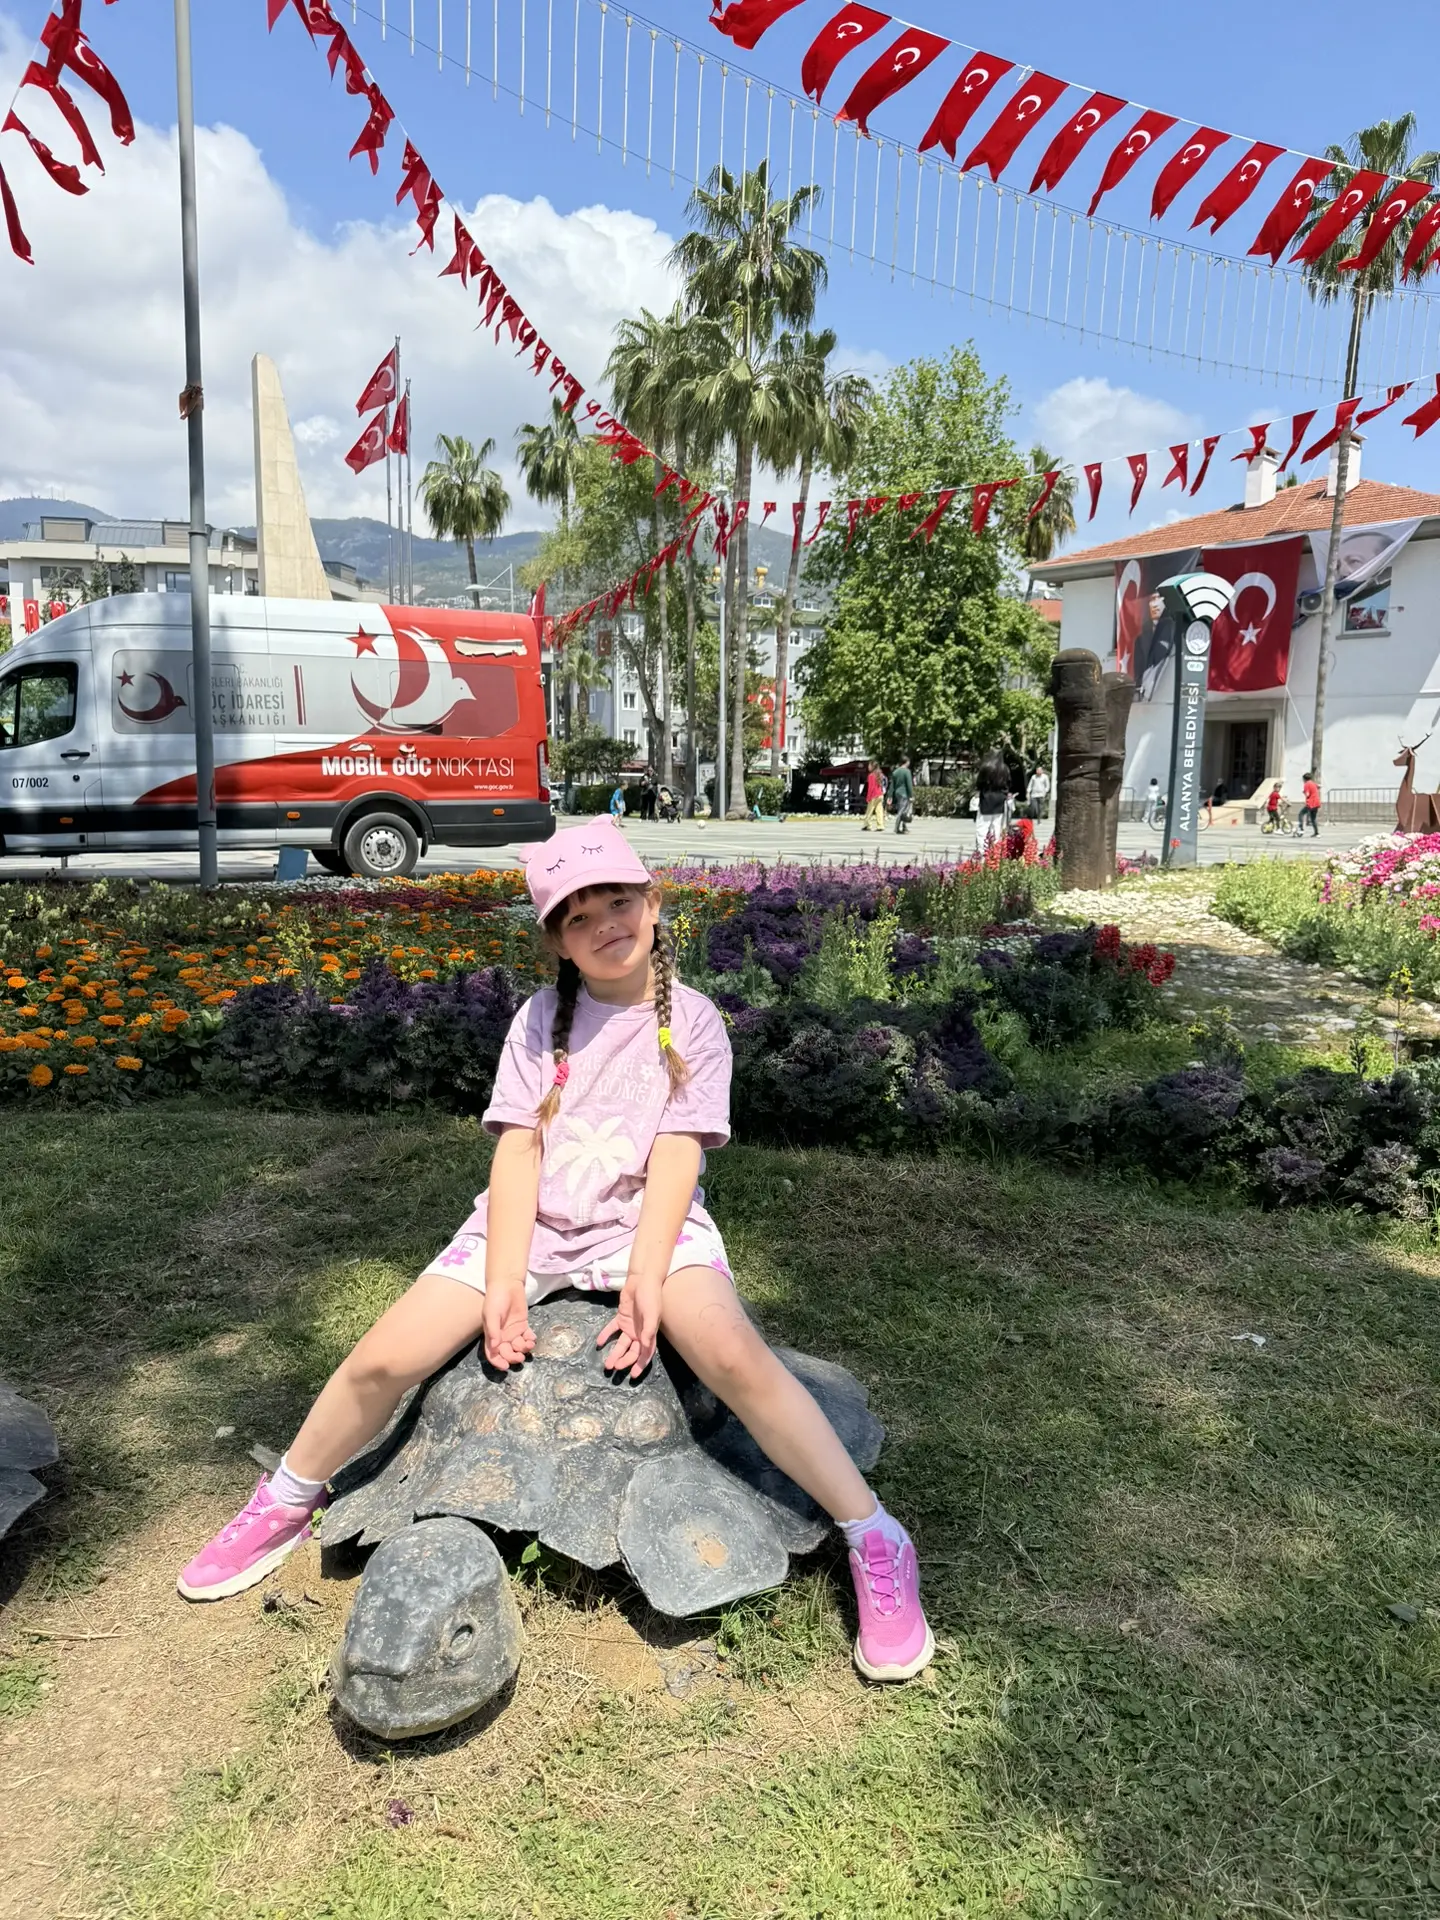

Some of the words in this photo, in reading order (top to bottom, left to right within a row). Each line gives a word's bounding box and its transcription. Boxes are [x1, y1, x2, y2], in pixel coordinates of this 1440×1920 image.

[231, 691, 284, 709] İDARESİ
[212, 712, 286, 728] AŞKANLIĞI
[1184, 682, 1200, 768] BELEDİYESİ
[322, 753, 388, 776] MOBİL
[393, 753, 432, 777] GÖÇ
[436, 757, 514, 777] NOKTASI
[12, 777, 49, 789] 07/002
[1179, 772, 1194, 831] ALANYA
